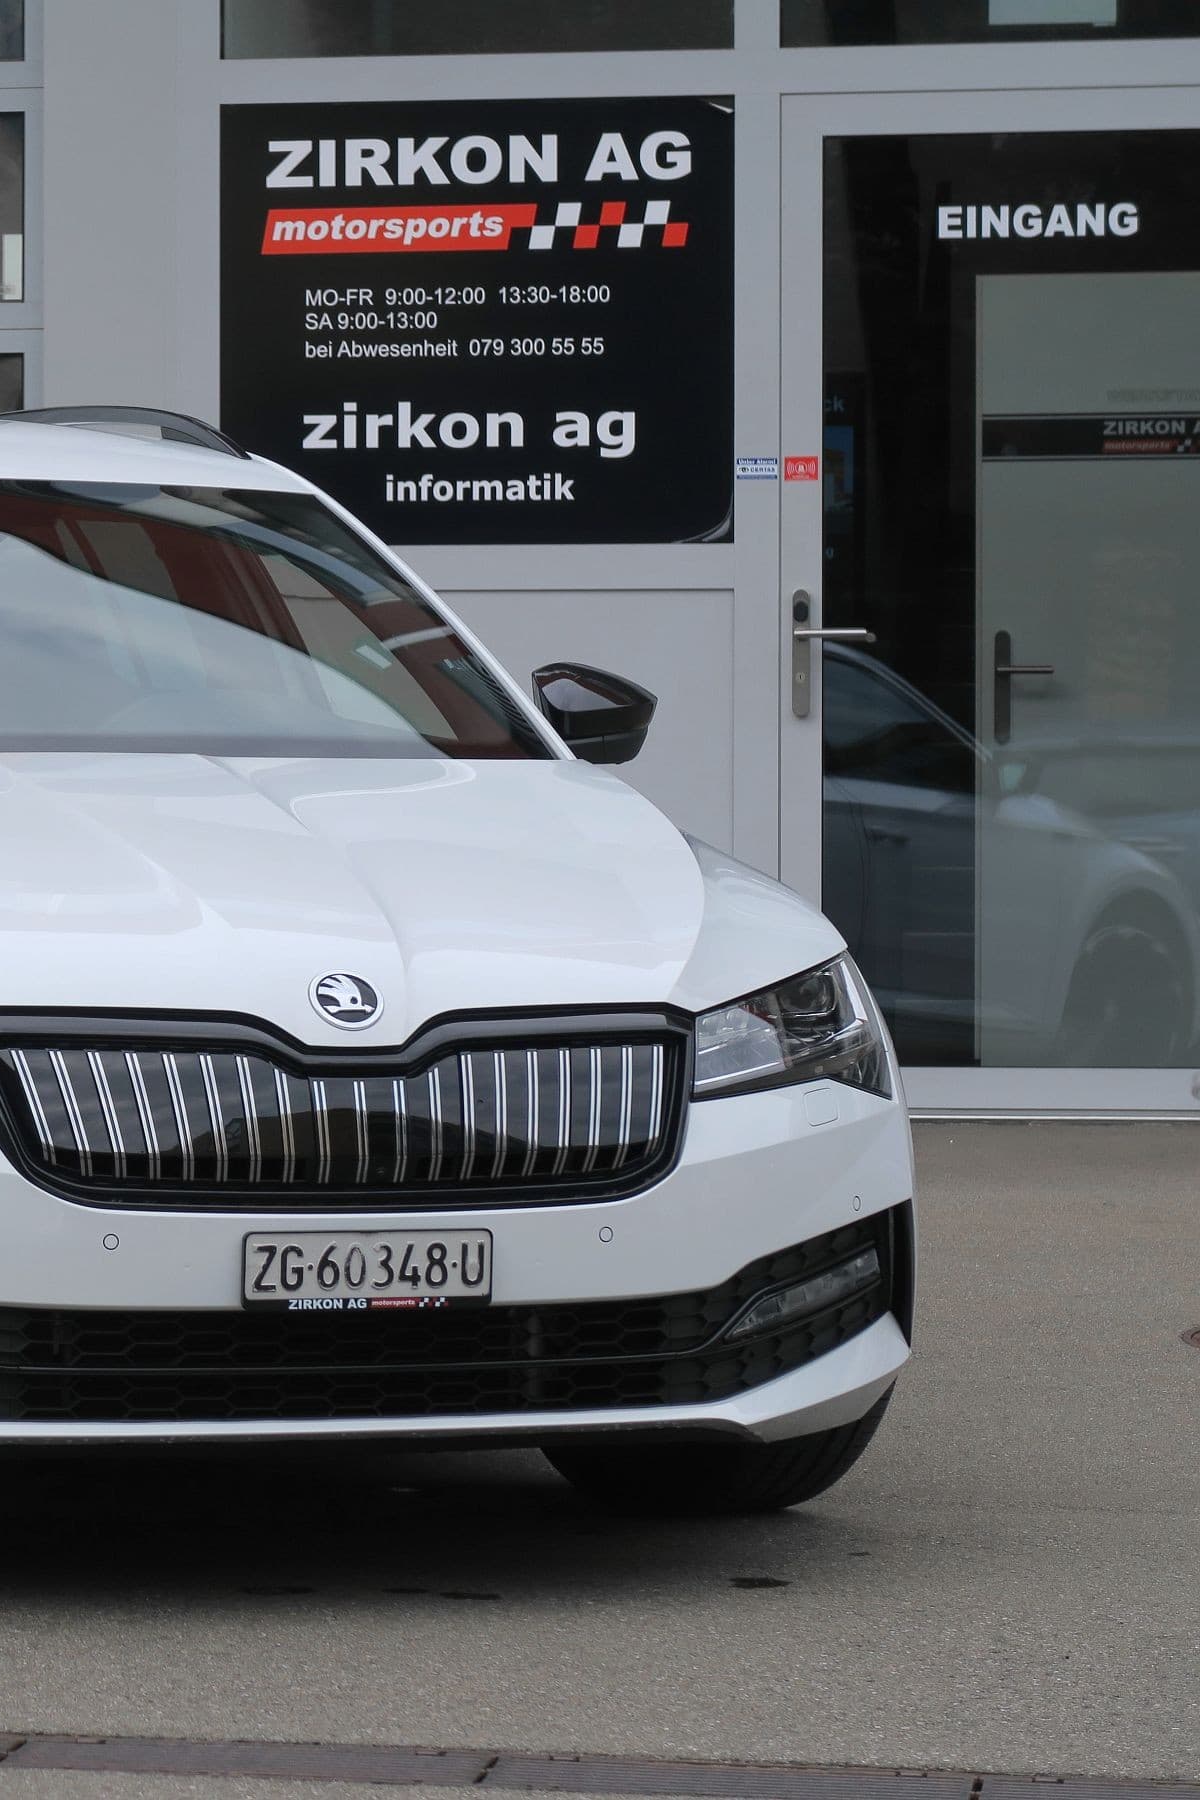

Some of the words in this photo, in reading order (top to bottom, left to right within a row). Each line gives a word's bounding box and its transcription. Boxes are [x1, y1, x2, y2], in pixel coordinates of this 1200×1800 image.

[266, 134, 558, 189] ZIRKON
[585, 130, 692, 182] AG
[272, 211, 504, 246] motorsports
[938, 203, 1139, 239] EINGANG
[305, 288, 374, 307] MO-FR
[385, 287, 486, 306] 9:00-12:00
[499, 285, 611, 304] 13:30-18:00
[305, 313, 333, 330] SA
[338, 311, 438, 330] 9:00-13:00
[305, 340, 333, 358] bei
[337, 339, 458, 358] Abwesenheit
[469, 338, 505, 357] 079
[511, 338, 546, 356] 300
[552, 338, 575, 356] 55
[581, 337, 605, 356] 55
[302, 402, 524, 450] zirkon
[552, 410, 636, 458] ag
[1103, 420, 1186, 436] ZIRKON
[386, 472, 575, 502] informatik
[288, 1298, 344, 1310] ZIRKON
[347, 1298, 368, 1310] AG
[371, 1299, 416, 1308] motorsports
